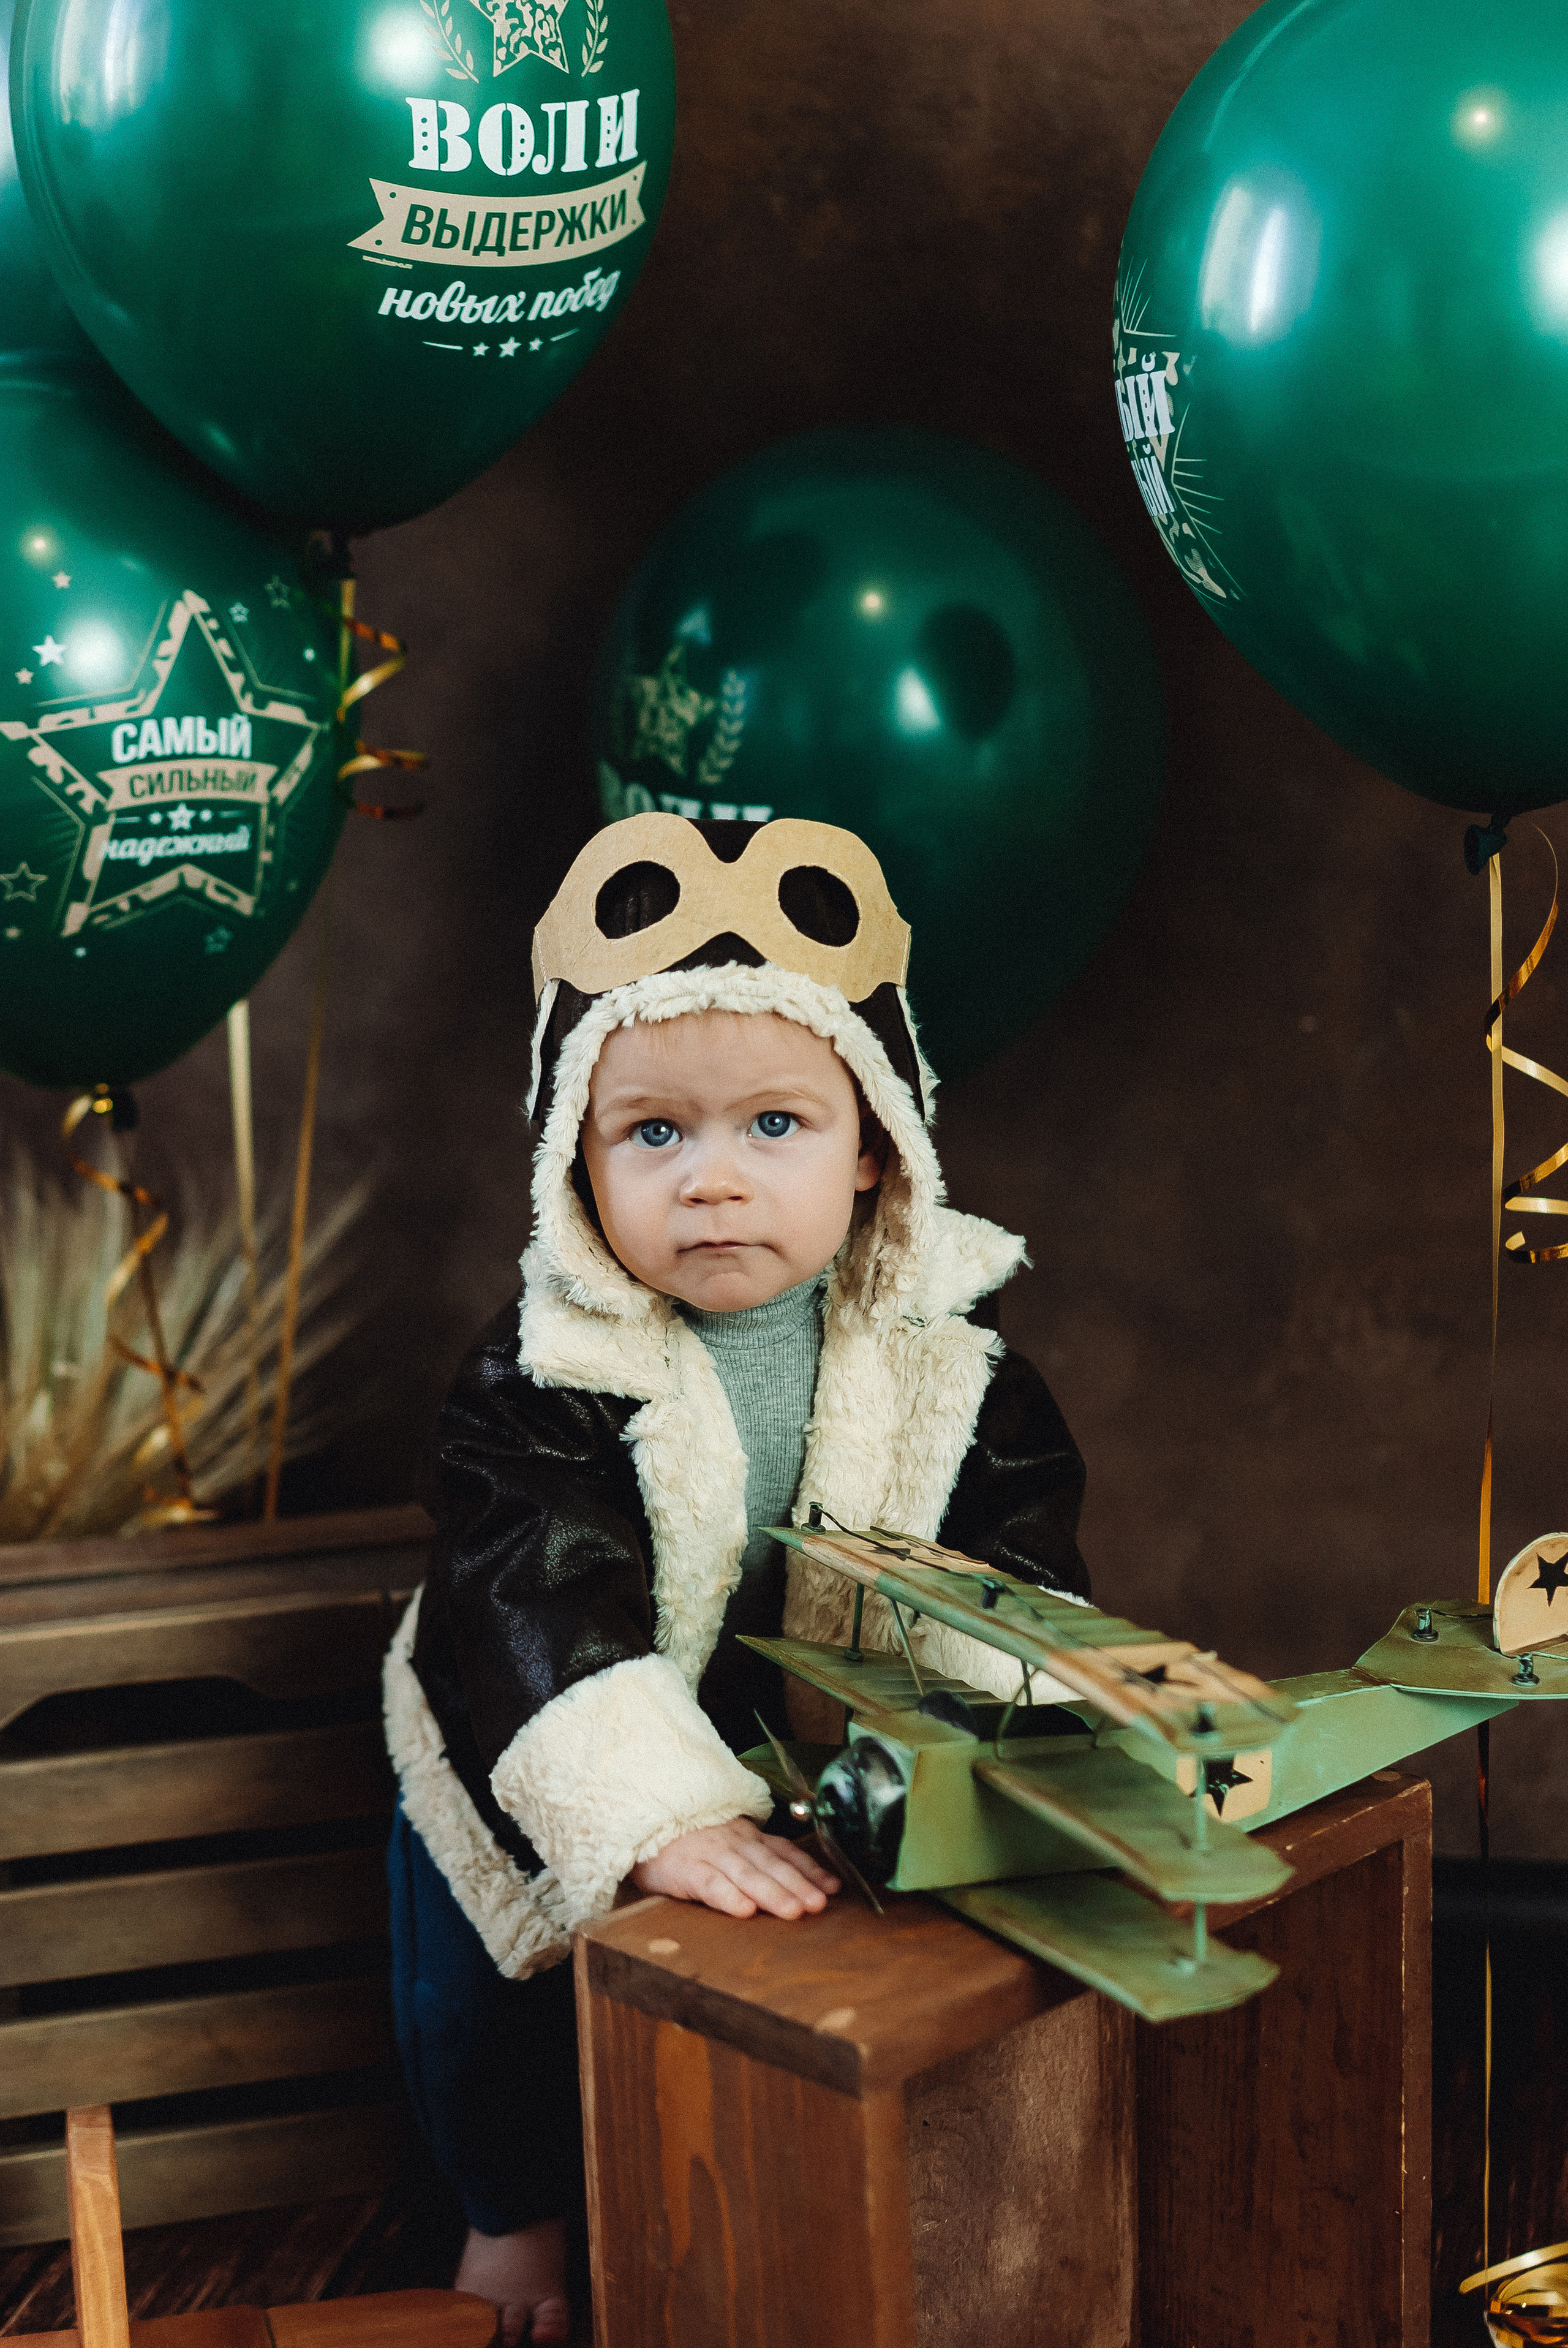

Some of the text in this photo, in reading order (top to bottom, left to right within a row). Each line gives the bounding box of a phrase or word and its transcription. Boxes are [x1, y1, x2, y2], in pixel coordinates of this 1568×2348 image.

[405, 88, 640, 176] ВОЛИ
[401, 189, 627, 257] ВЫДЕРЖКИ
[378, 266, 621, 323] новых побед
[112, 712, 252, 763] САМЫЙ
[129, 767, 257, 799] СИЛЬНЫЙ
